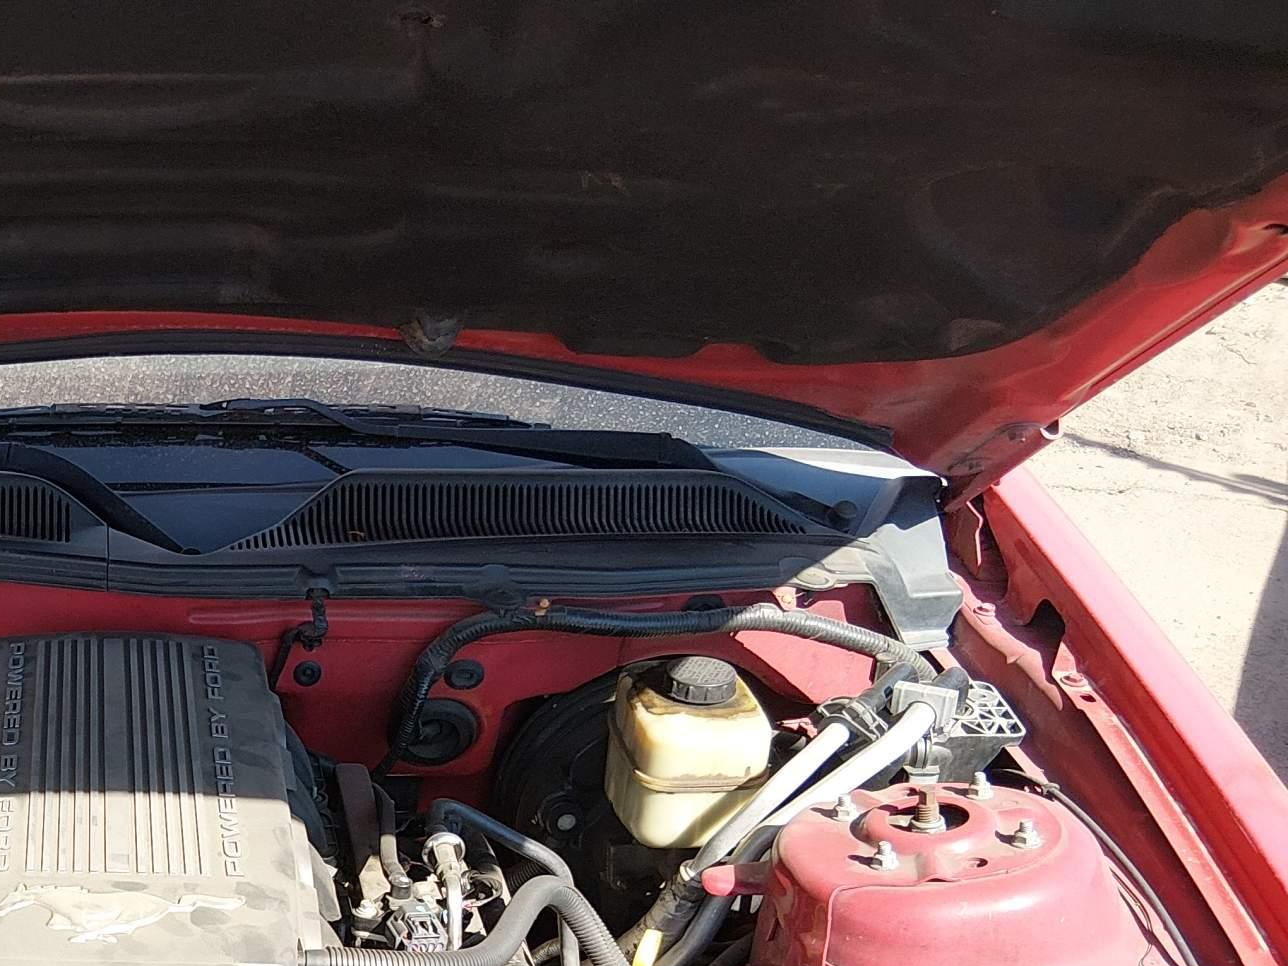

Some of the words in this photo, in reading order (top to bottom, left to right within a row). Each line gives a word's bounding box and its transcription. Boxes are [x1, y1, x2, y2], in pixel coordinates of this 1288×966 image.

[2, 642, 26, 746] POWERED
[203, 645, 224, 701] FORD
[210, 708, 229, 739] BY
[215, 748, 245, 877] POWERED
